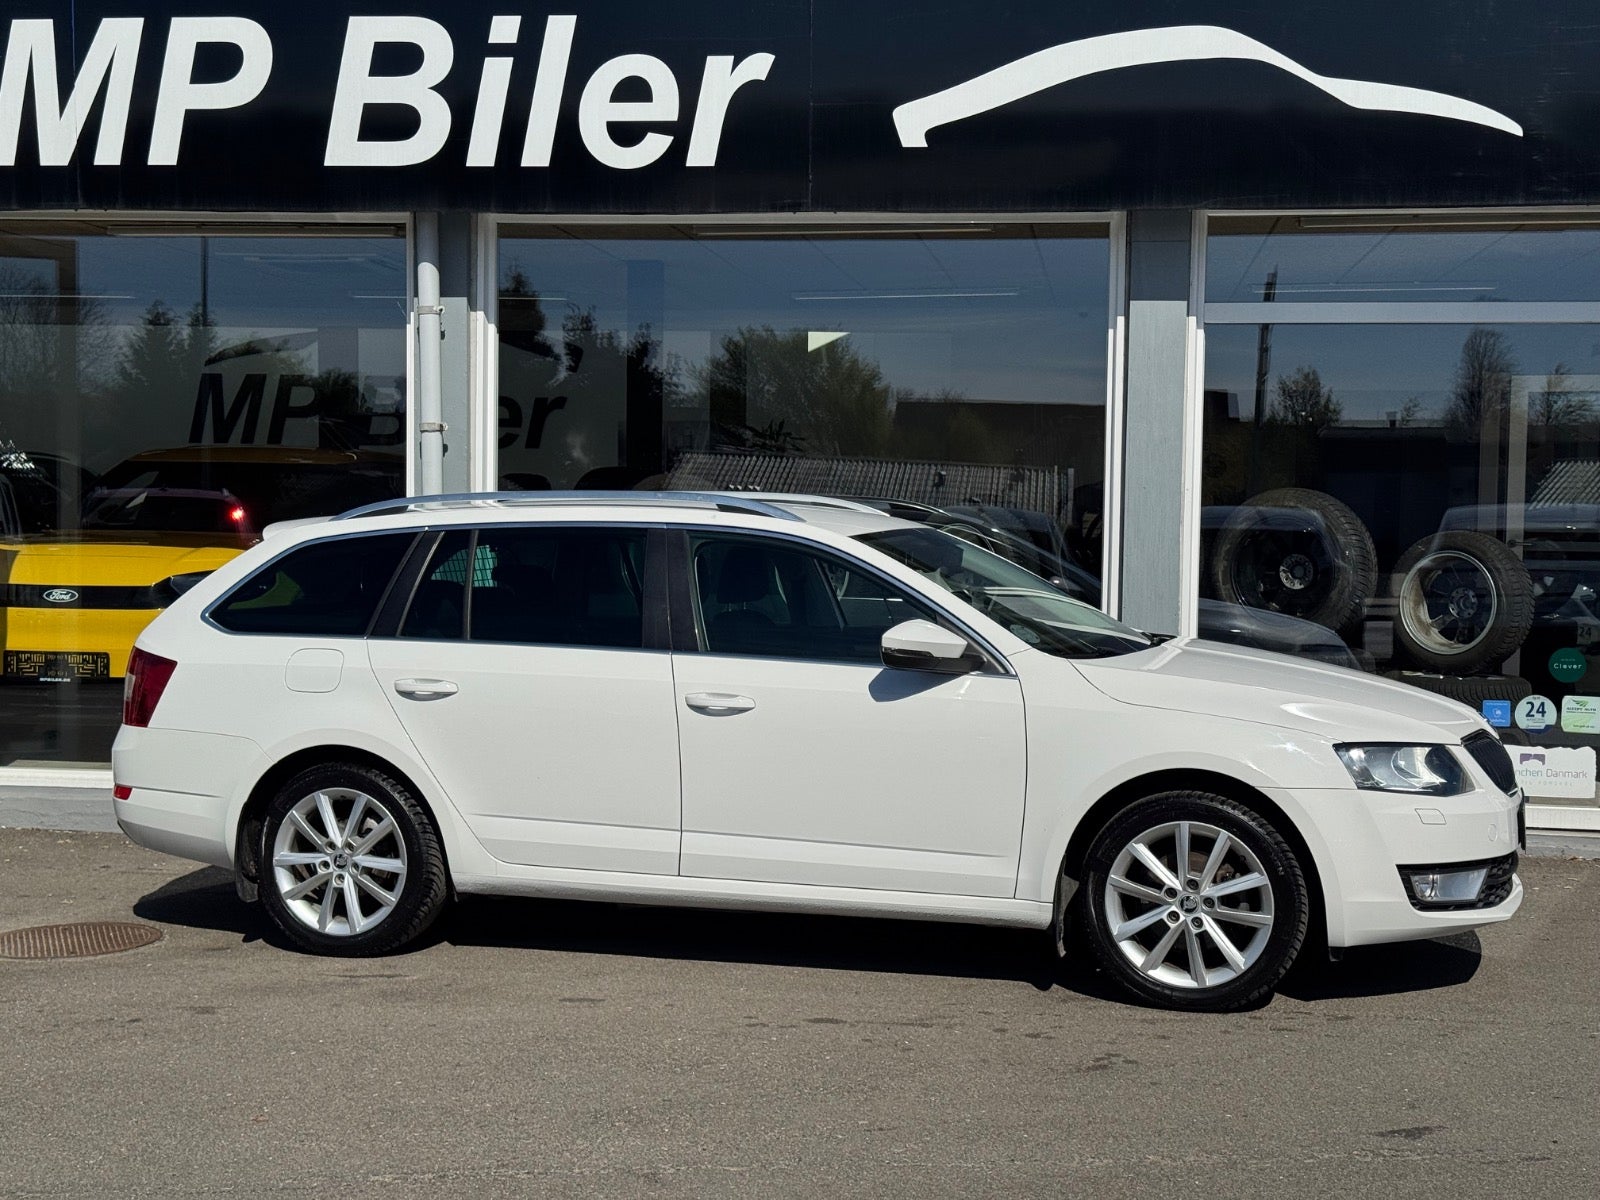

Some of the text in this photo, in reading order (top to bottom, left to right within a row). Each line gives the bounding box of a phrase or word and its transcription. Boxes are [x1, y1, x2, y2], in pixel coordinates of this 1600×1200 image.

[0, 15, 776, 169] MP Biler
[188, 373, 319, 445] MP
[48, 590, 71, 600] Ford
[1525, 701, 1547, 718] 24
[1545, 768, 1588, 779] Danmark
